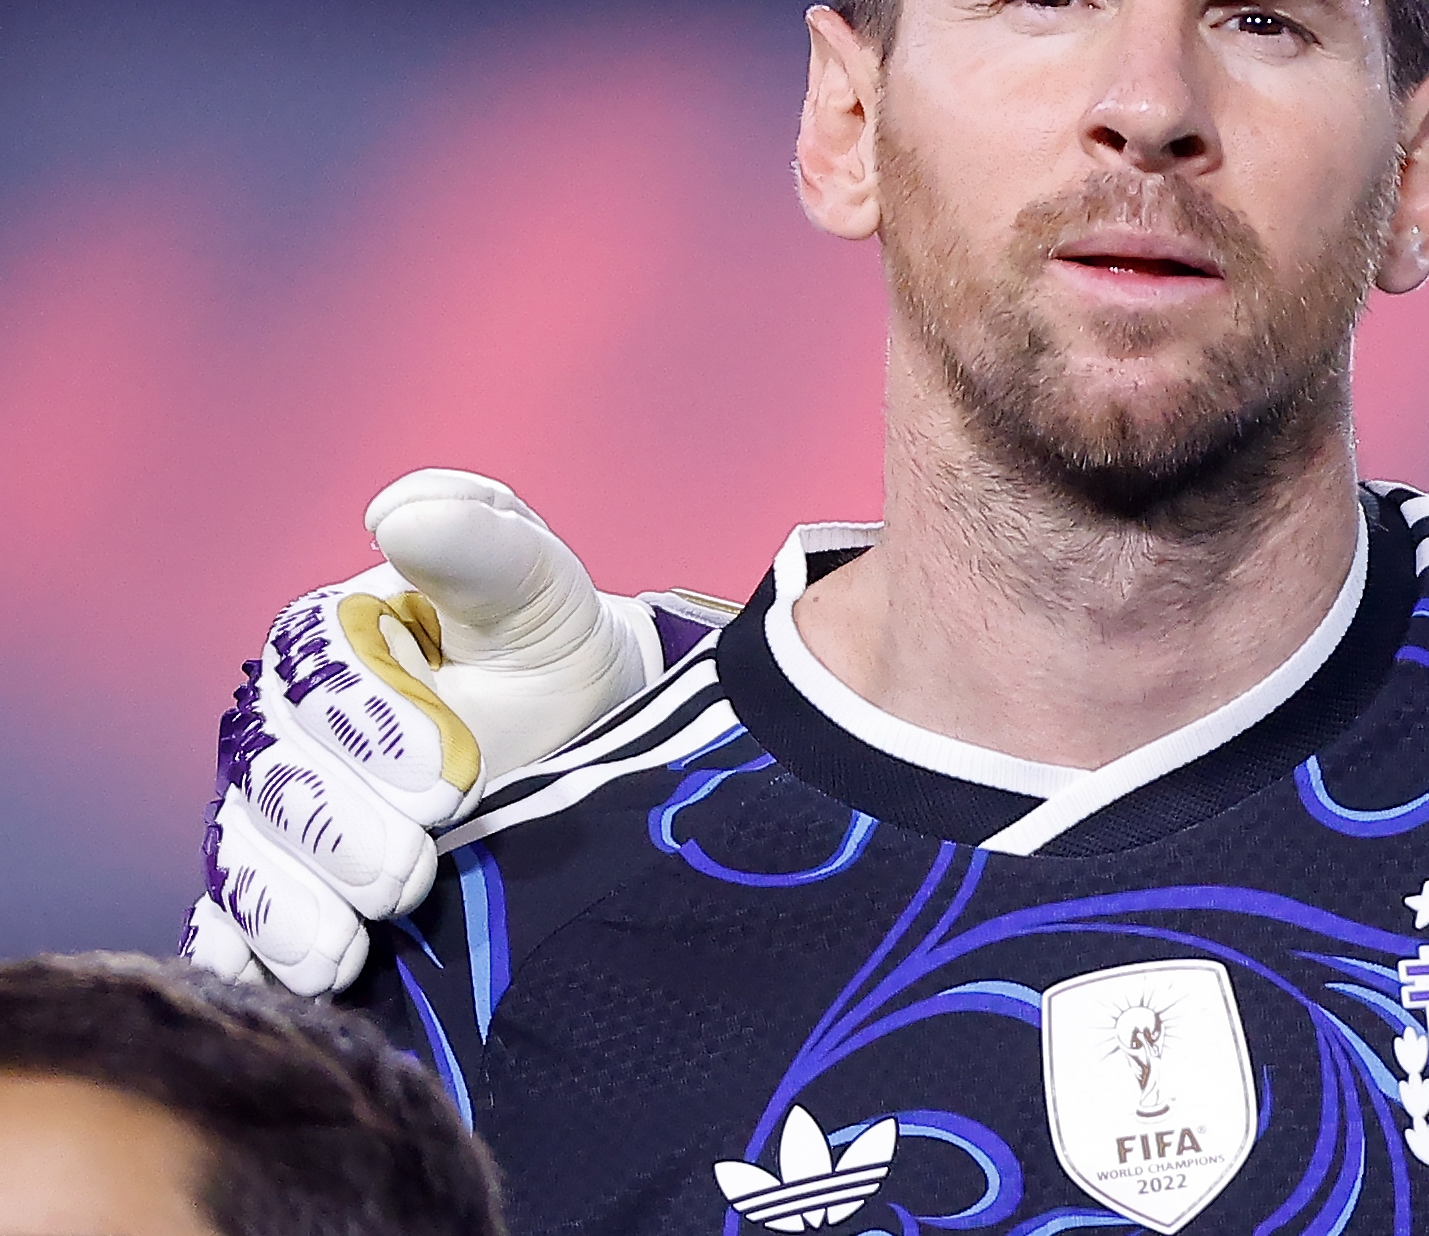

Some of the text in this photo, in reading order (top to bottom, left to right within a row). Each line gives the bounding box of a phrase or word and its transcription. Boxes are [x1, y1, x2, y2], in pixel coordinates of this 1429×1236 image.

[1097, 1154, 1225, 1181] WORLD CHAMPIONS
[1137, 1173, 1187, 1195] 2022
